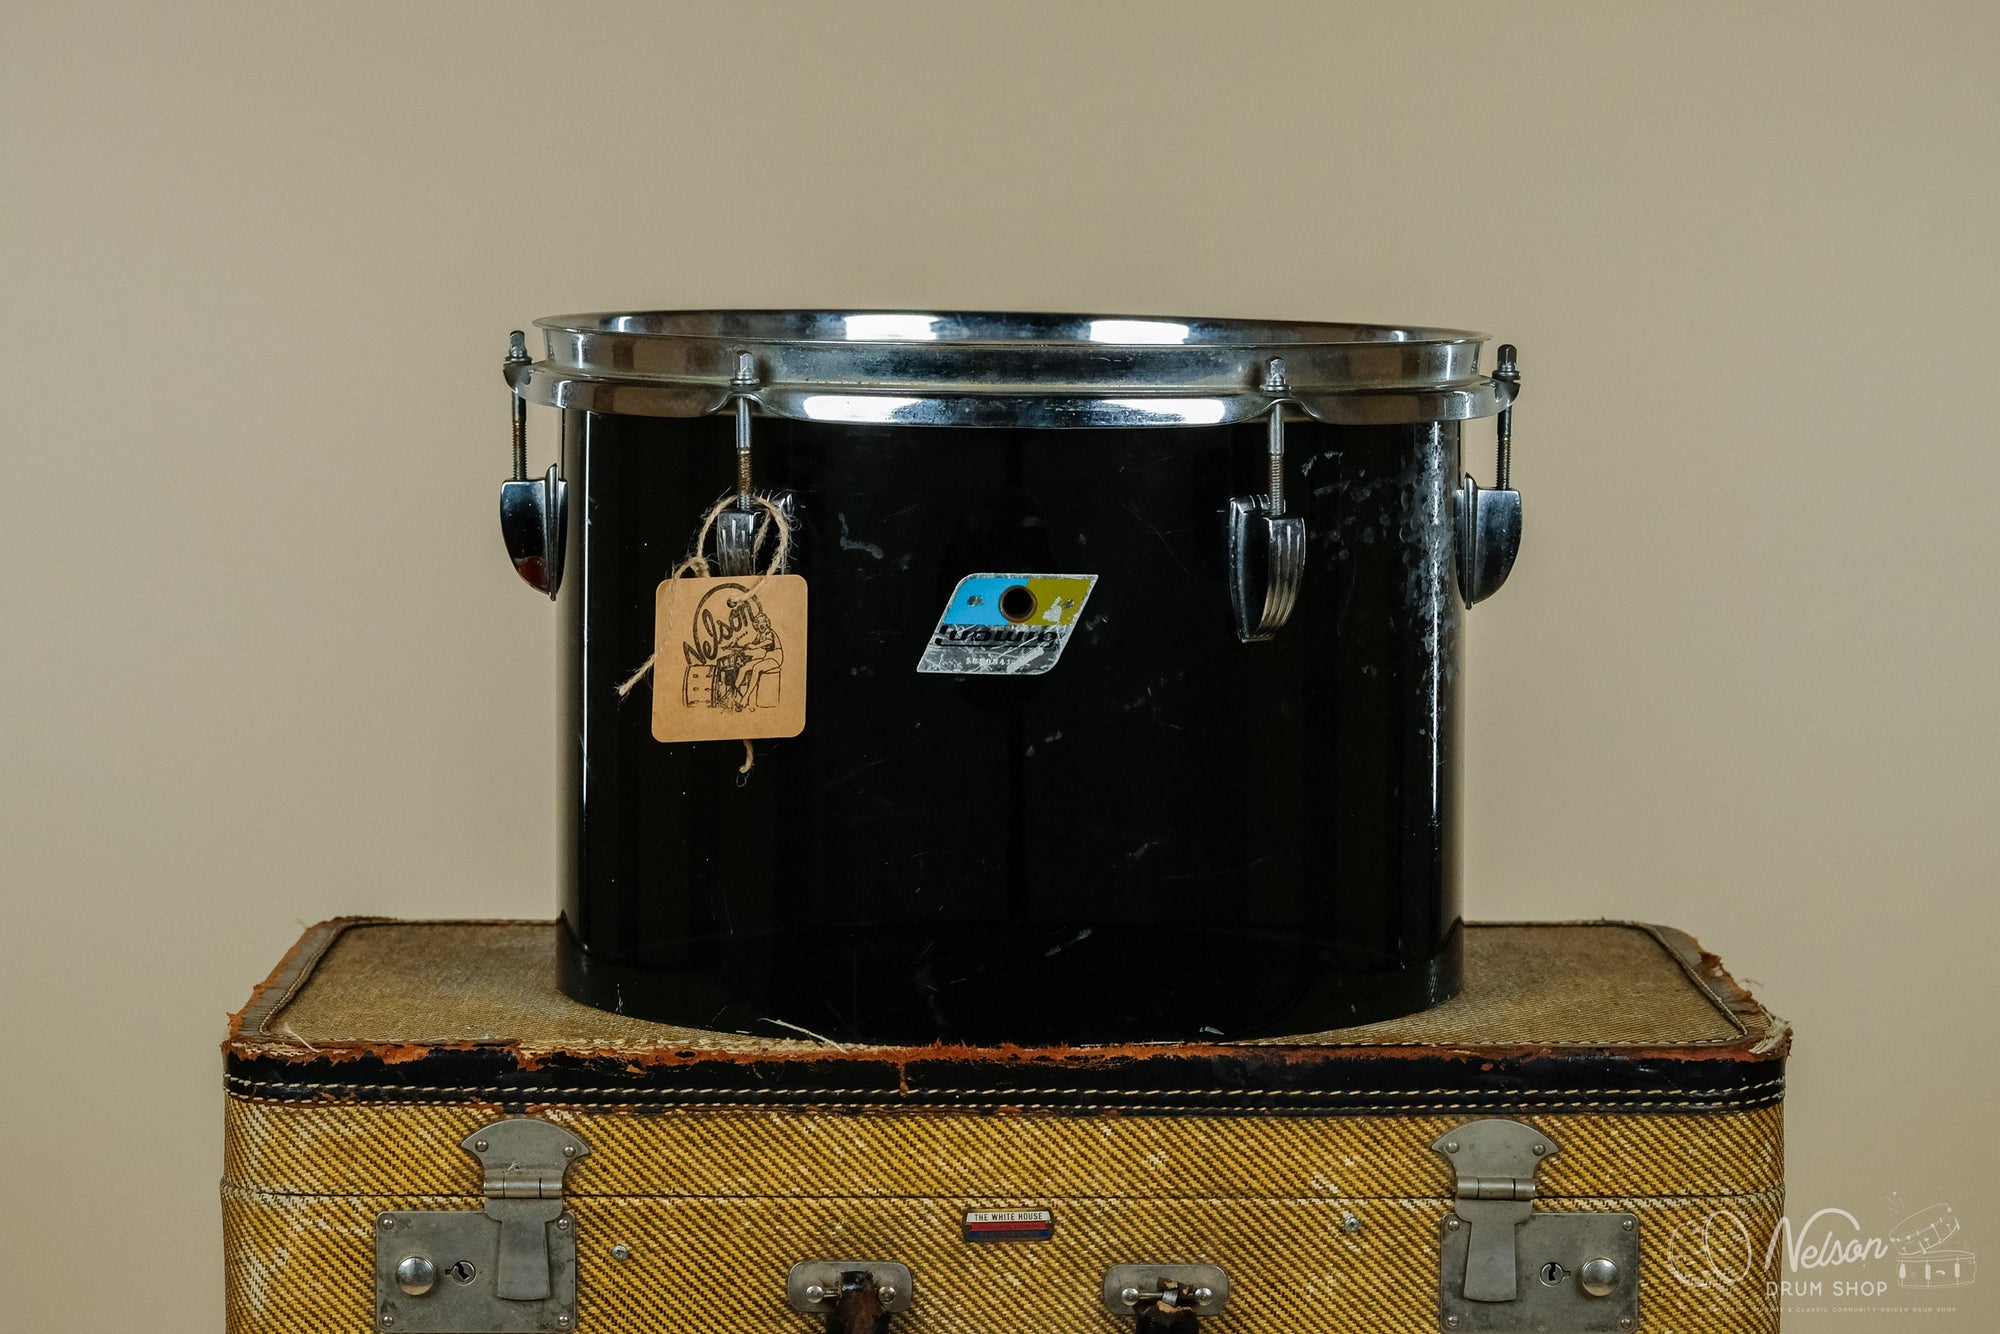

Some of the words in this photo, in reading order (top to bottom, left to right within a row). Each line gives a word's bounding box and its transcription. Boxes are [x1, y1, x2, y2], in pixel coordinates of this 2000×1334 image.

[683, 583, 764, 665] Nelson
[974, 1213, 989, 1222] THE
[991, 1213, 1015, 1221] WHITE
[1018, 1212, 1043, 1221] HOUSE
